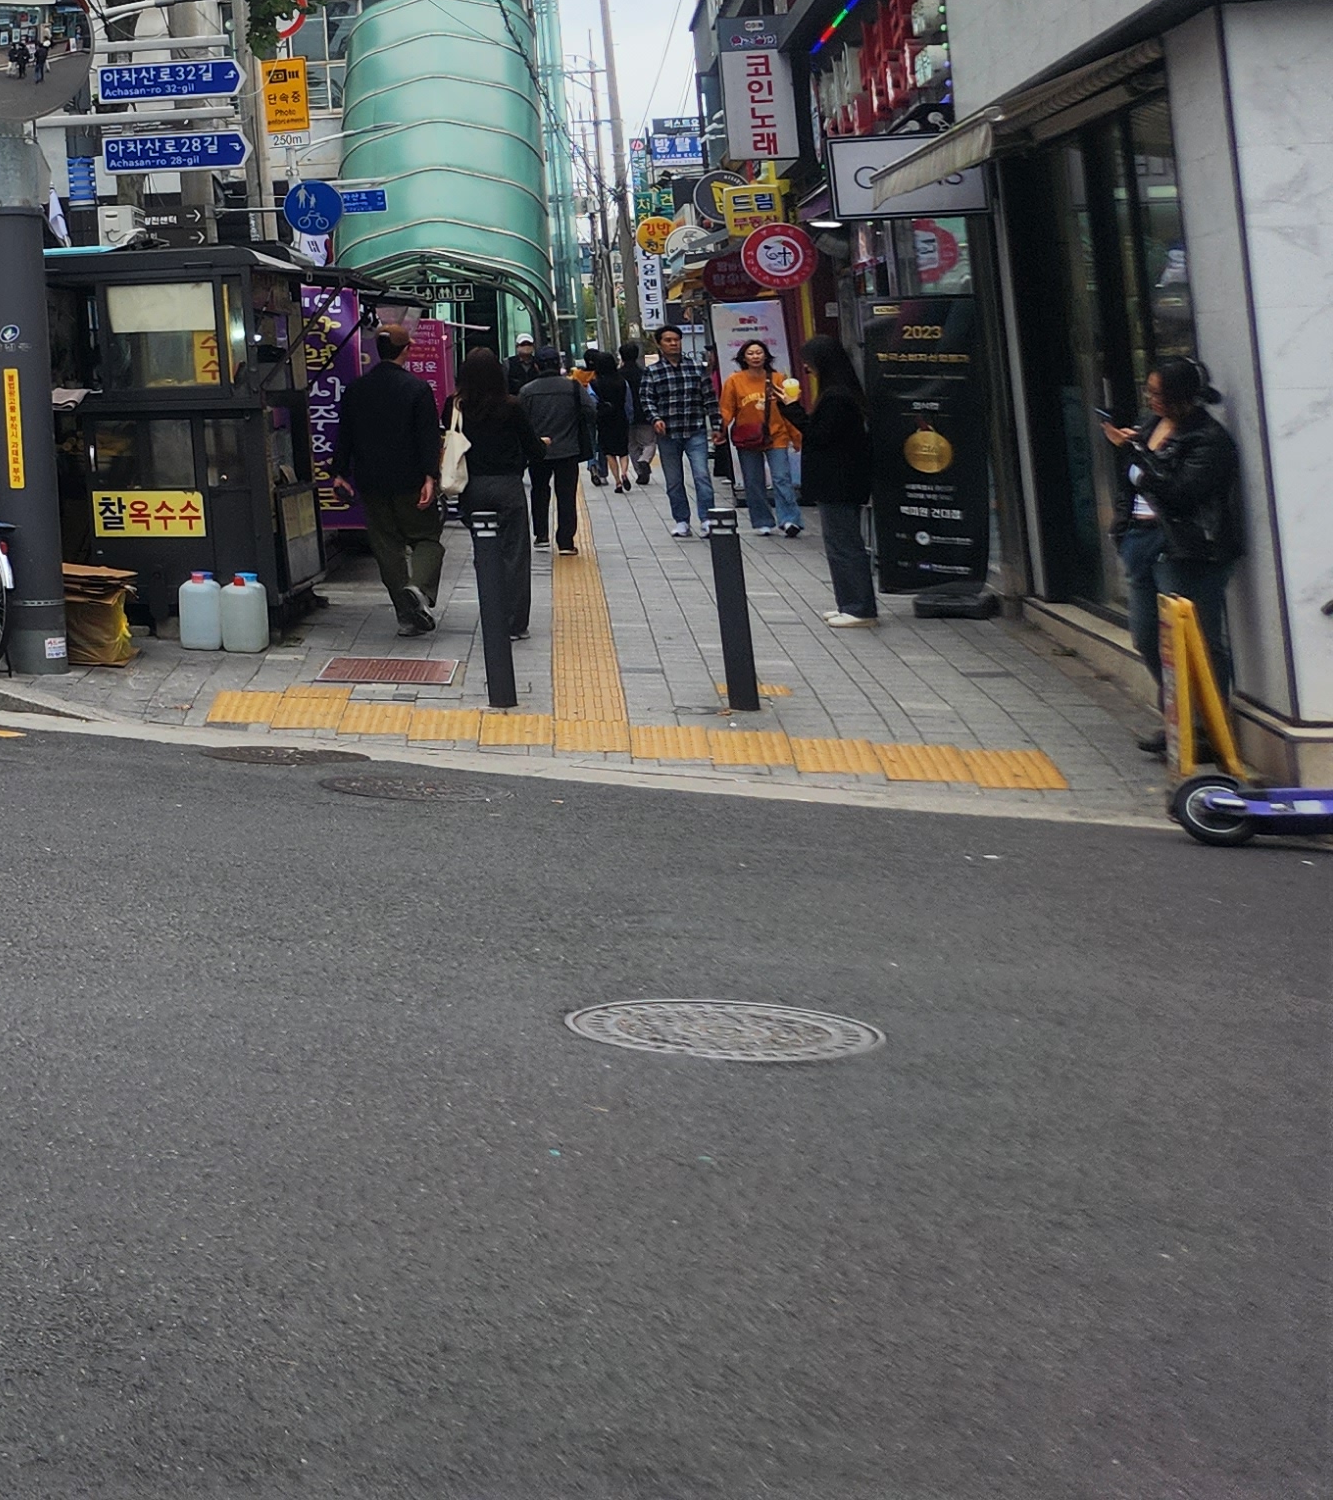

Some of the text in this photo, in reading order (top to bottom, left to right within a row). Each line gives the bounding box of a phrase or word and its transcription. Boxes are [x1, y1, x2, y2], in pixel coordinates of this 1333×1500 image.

[103, 63, 214, 88] 아차산로32길
[103, 81, 196, 99] Achasan-ro 32-gil
[267, 90, 301, 106] 단속중
[275, 107, 297, 117] Photo
[746, 54, 780, 156] 코인노래
[107, 135, 219, 159] 아차산로28길
[273, 135, 303, 147] 250m
[109, 154, 201, 170] Achasan-ro 28-gil
[732, 193, 775, 213] 드림
[902, 325, 942, 339] 2023
[97, 496, 202, 531] 찰옥수수
